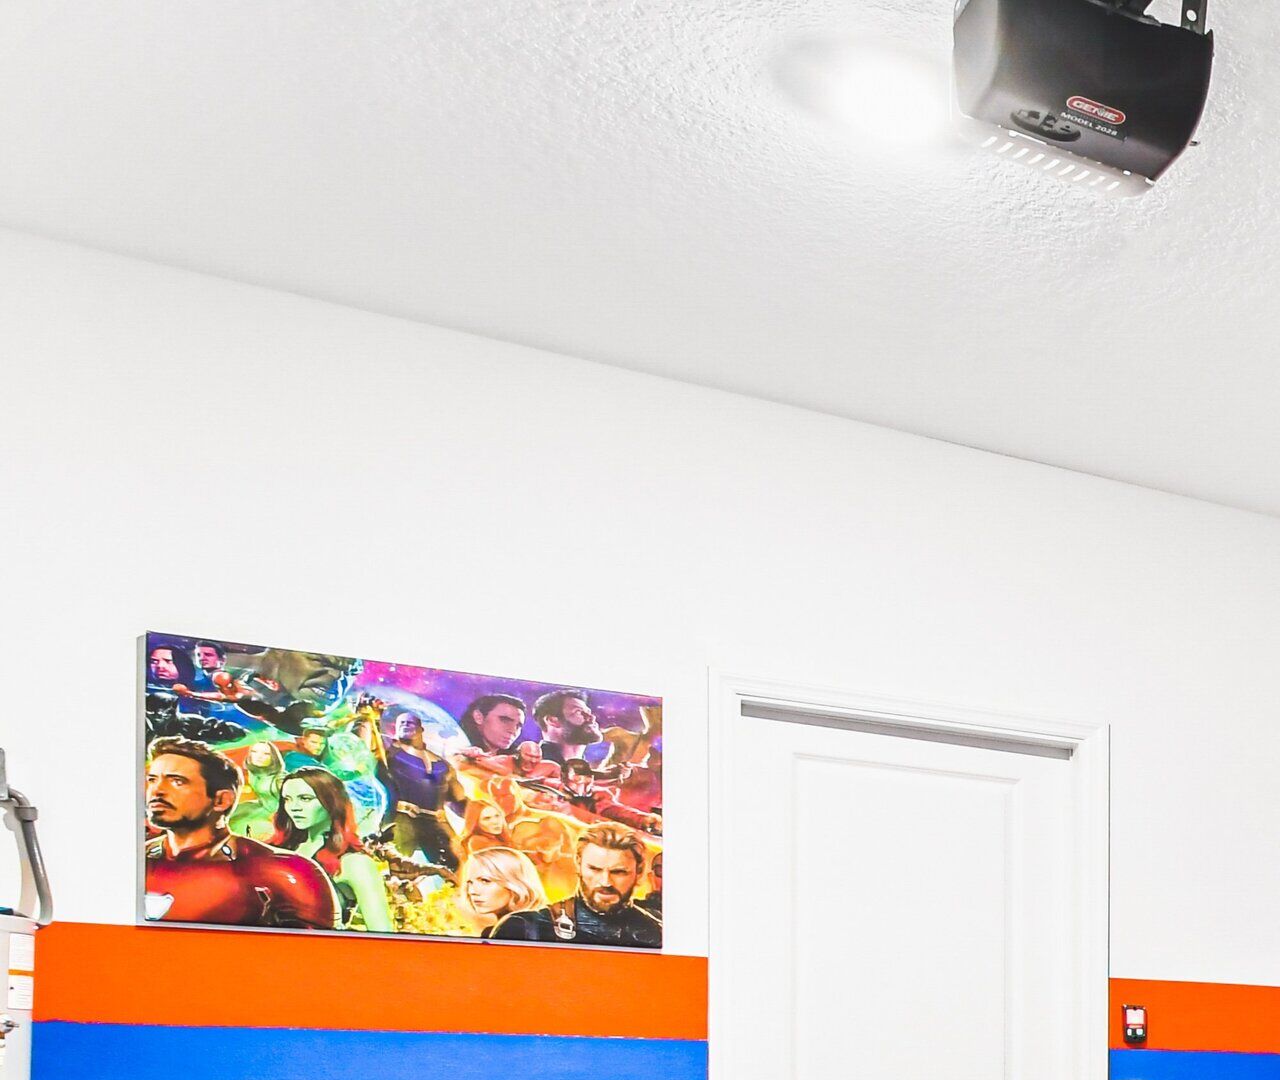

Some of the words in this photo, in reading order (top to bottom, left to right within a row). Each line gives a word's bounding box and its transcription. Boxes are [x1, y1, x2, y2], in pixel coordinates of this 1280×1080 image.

[1072, 100, 1119, 122] GENIE
[1060, 112, 1093, 128] MODEL
[1095, 124, 1118, 136] 2028
